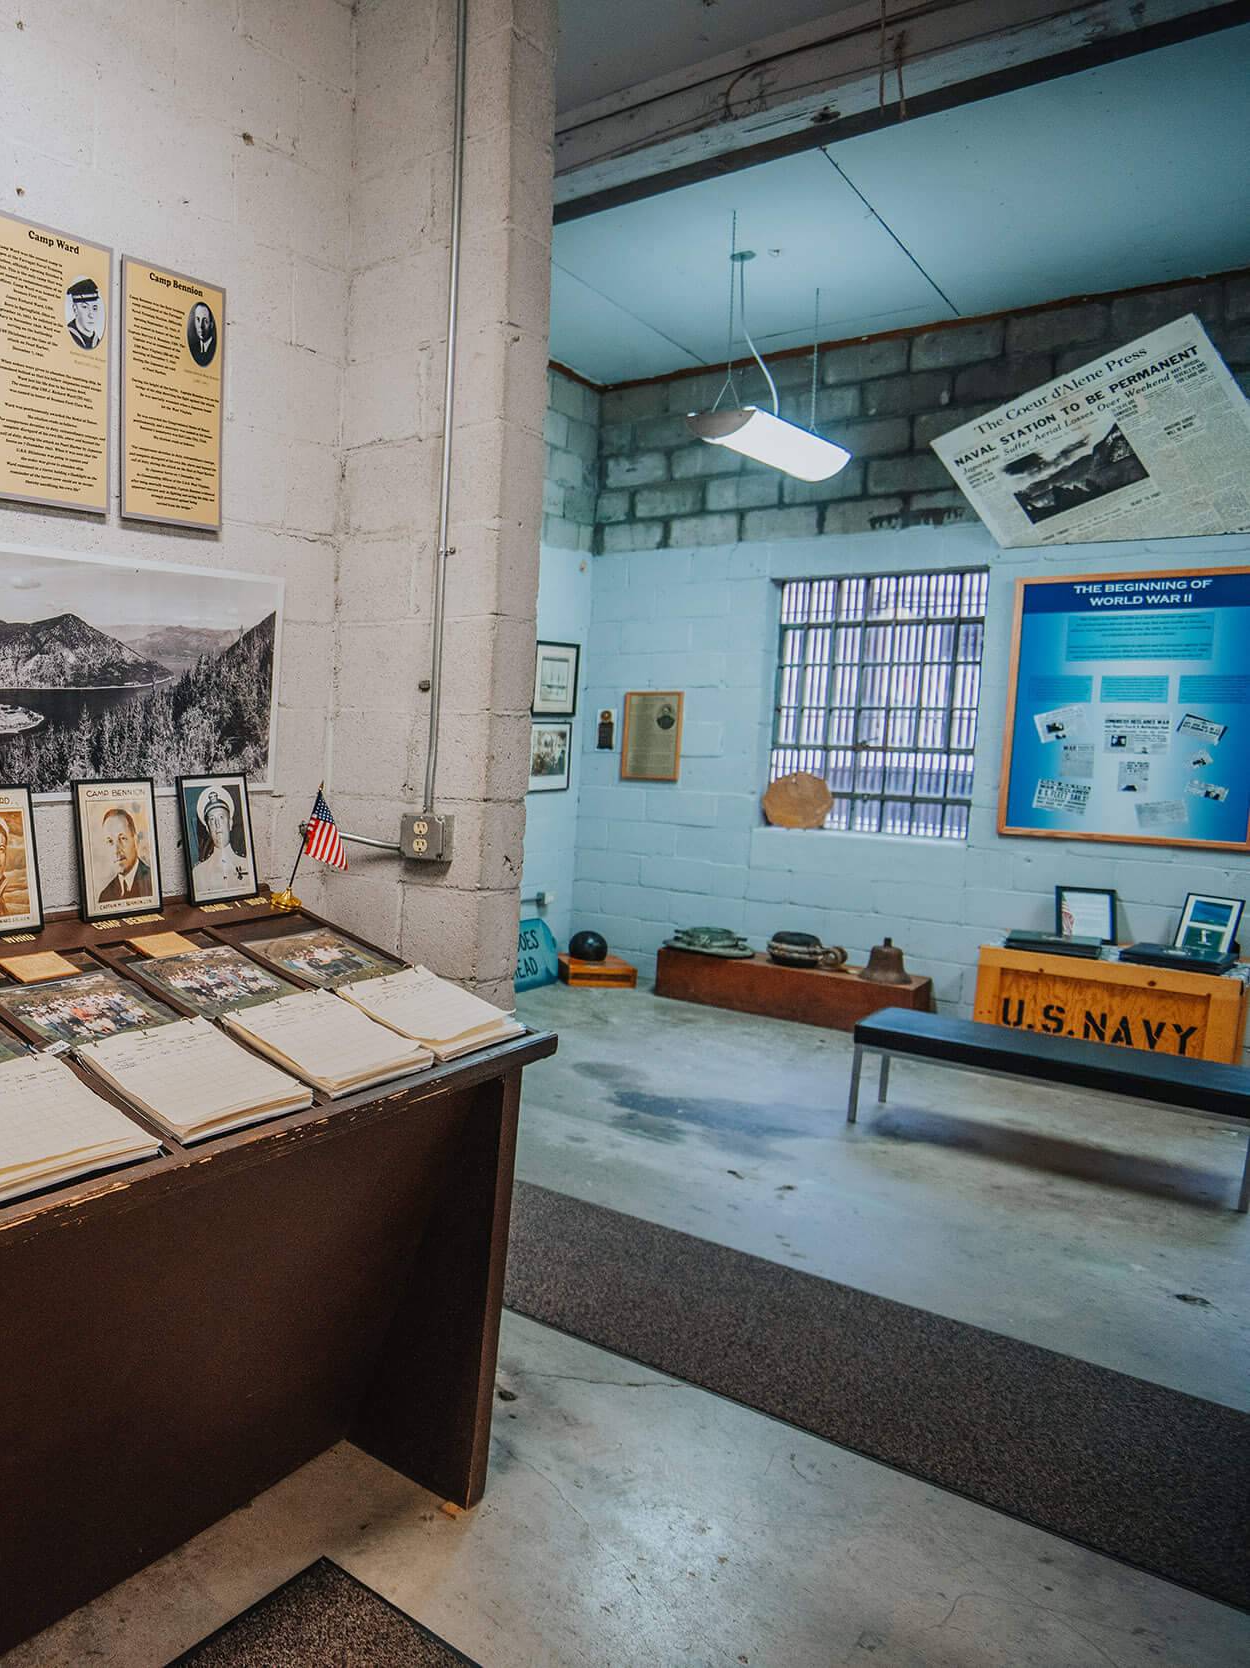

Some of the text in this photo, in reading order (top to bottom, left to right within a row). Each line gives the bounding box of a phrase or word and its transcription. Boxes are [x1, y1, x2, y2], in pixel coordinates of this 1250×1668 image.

[28, 230, 80, 255] Camp Ward
[149, 272, 204, 297] Camp Bennion
[973, 348, 1148, 435] The Coeur d'Alene Press
[953, 443, 997, 467] NAVAL
[999, 413, 1057, 446] STATION
[1060, 402, 1081, 416] TO
[1085, 390, 1105, 406] BE
[1108, 345, 1199, 394] PERMANENT
[1003, 439, 1031, 457] Suffer
[1034, 423, 1062, 443] Aerial
[1064, 410, 1094, 428] Losses
[1097, 398, 1121, 412] Over
[1124, 372, 1171, 399] Weekend
[1073, 579, 1213, 595] THE BEGINNING OF
[1089, 593, 1193, 606] WORLD WAR II
[86, 788, 145, 798] CAMP BENNION
[91, 920, 122, 931] CAMP
[1, 933, 37, 944] WARD
